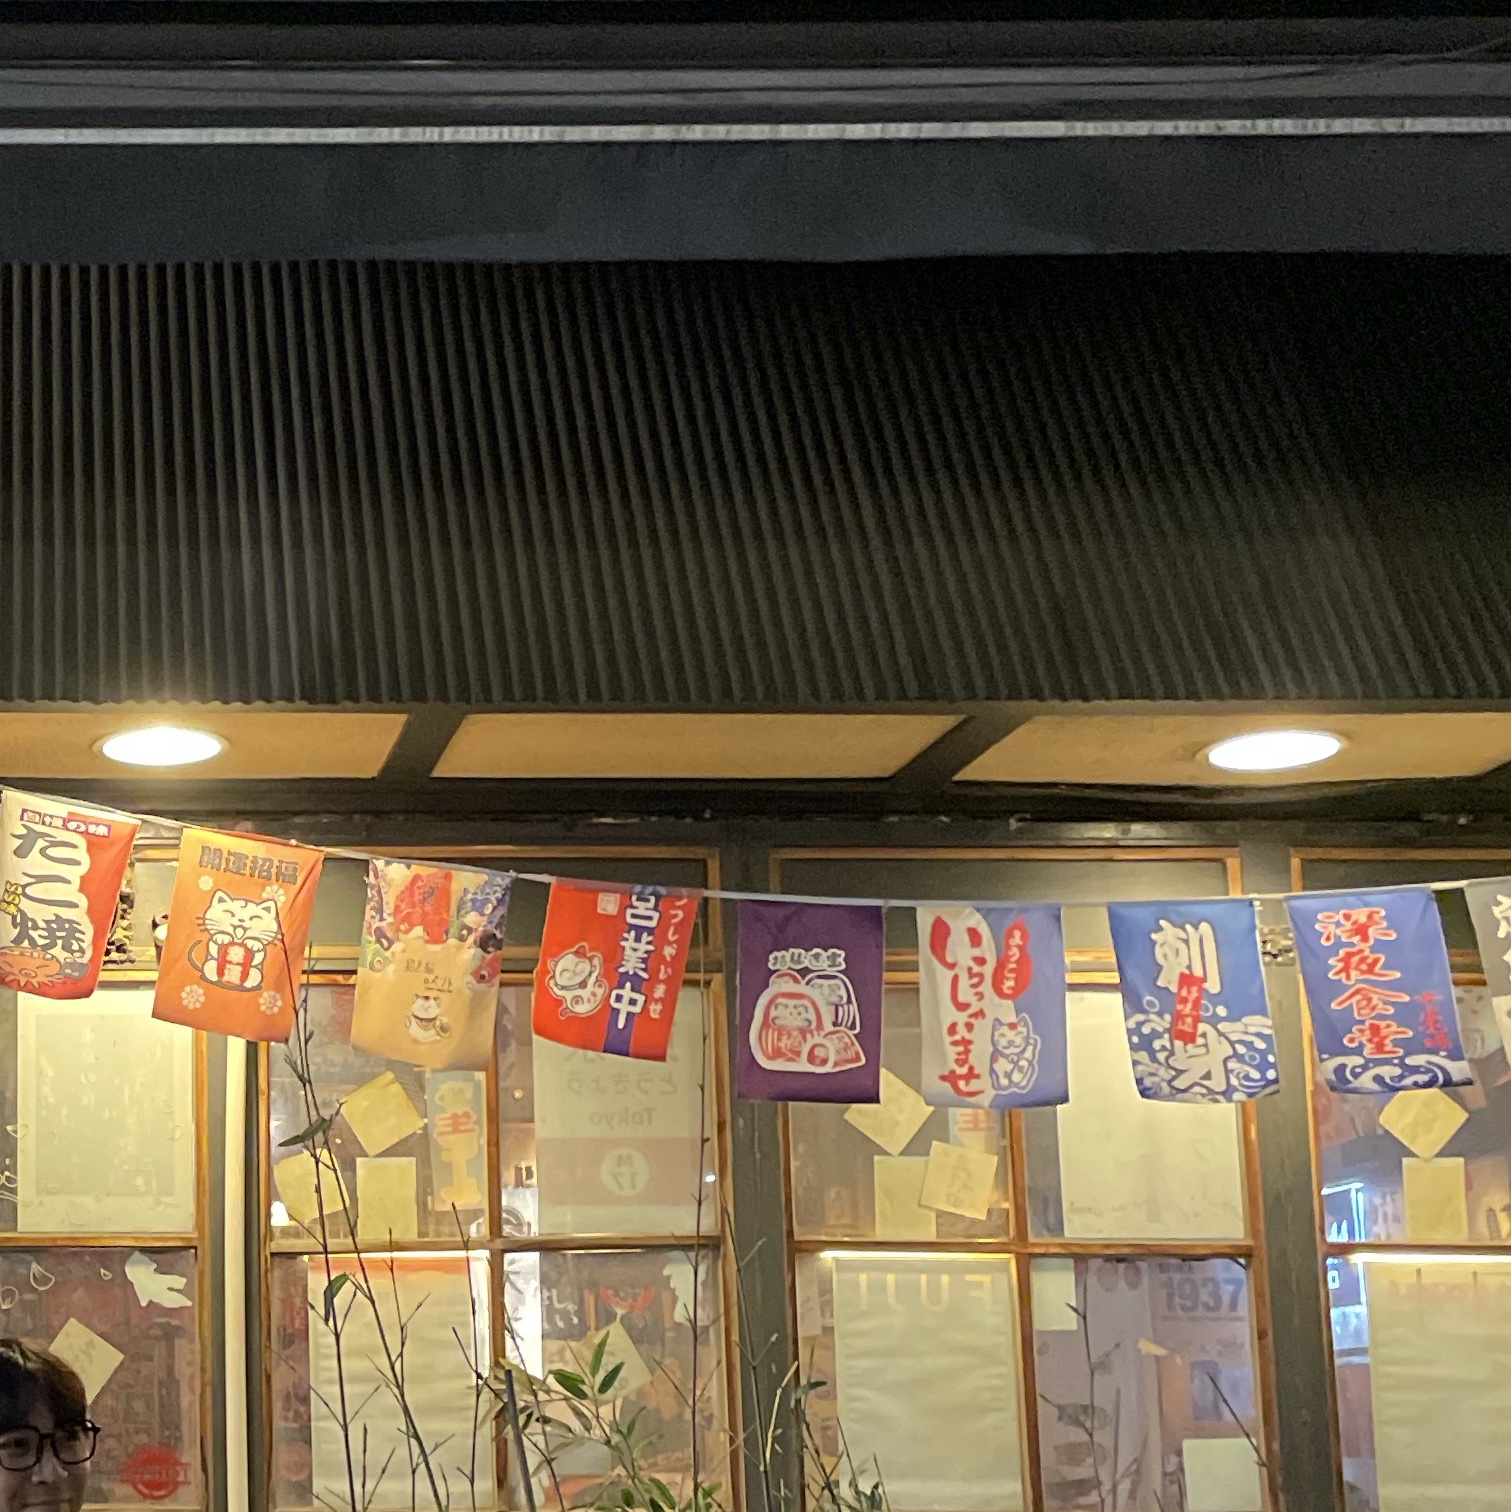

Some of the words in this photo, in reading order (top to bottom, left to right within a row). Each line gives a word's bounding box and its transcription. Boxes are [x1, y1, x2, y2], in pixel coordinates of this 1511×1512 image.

[10, 824, 86, 953] たこ焼
[198, 845, 302, 885] 開運招福
[929, 914, 987, 1098] いらっしゃいませ
[1001, 929, 1024, 996] ようこそ
[1149, 919, 1233, 1094] 刺身
[1314, 907, 1414, 1058] 深夜食堂
[1161, 1276, 1245, 1313] 1937
